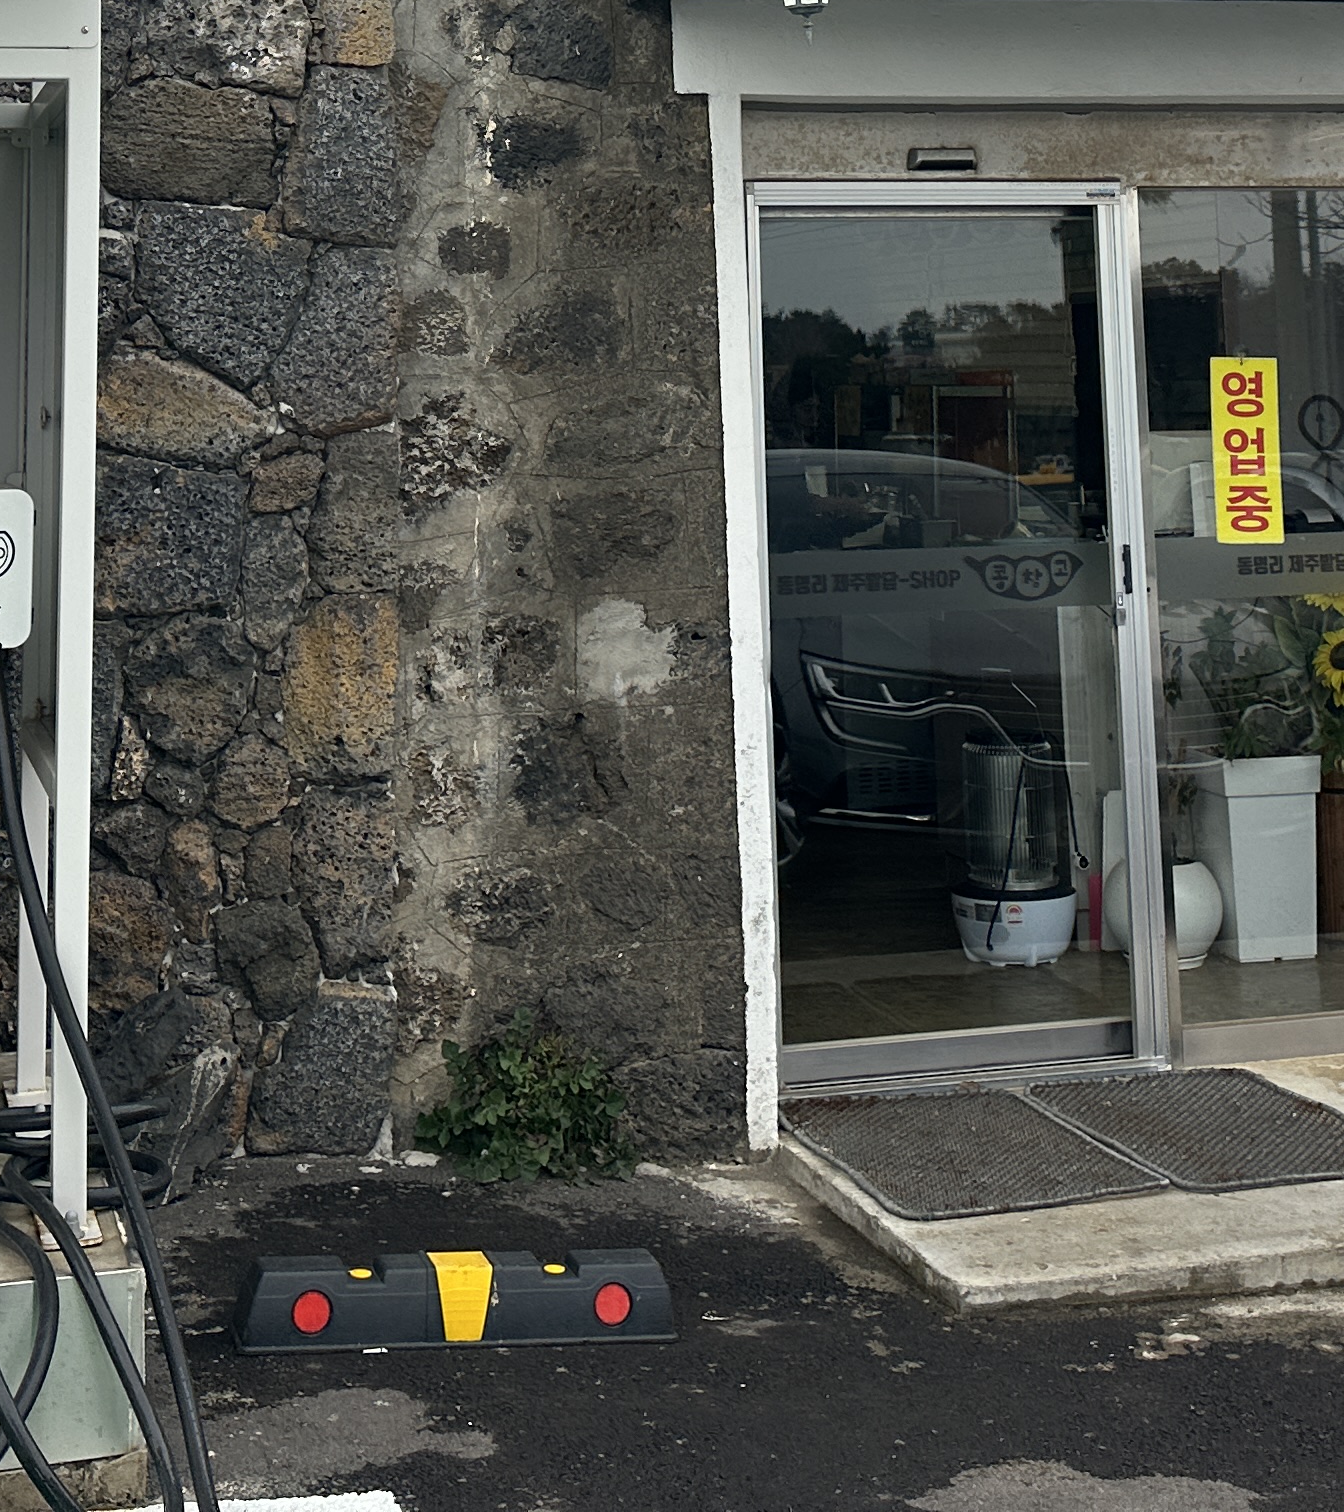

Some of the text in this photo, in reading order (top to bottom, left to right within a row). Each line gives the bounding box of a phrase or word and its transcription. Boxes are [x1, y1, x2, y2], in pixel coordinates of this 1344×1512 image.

[1222, 371, 1272, 533] 영업중
[1237, 555, 1283, 575] 동명리
[776, 575, 828, 596] 동명리
